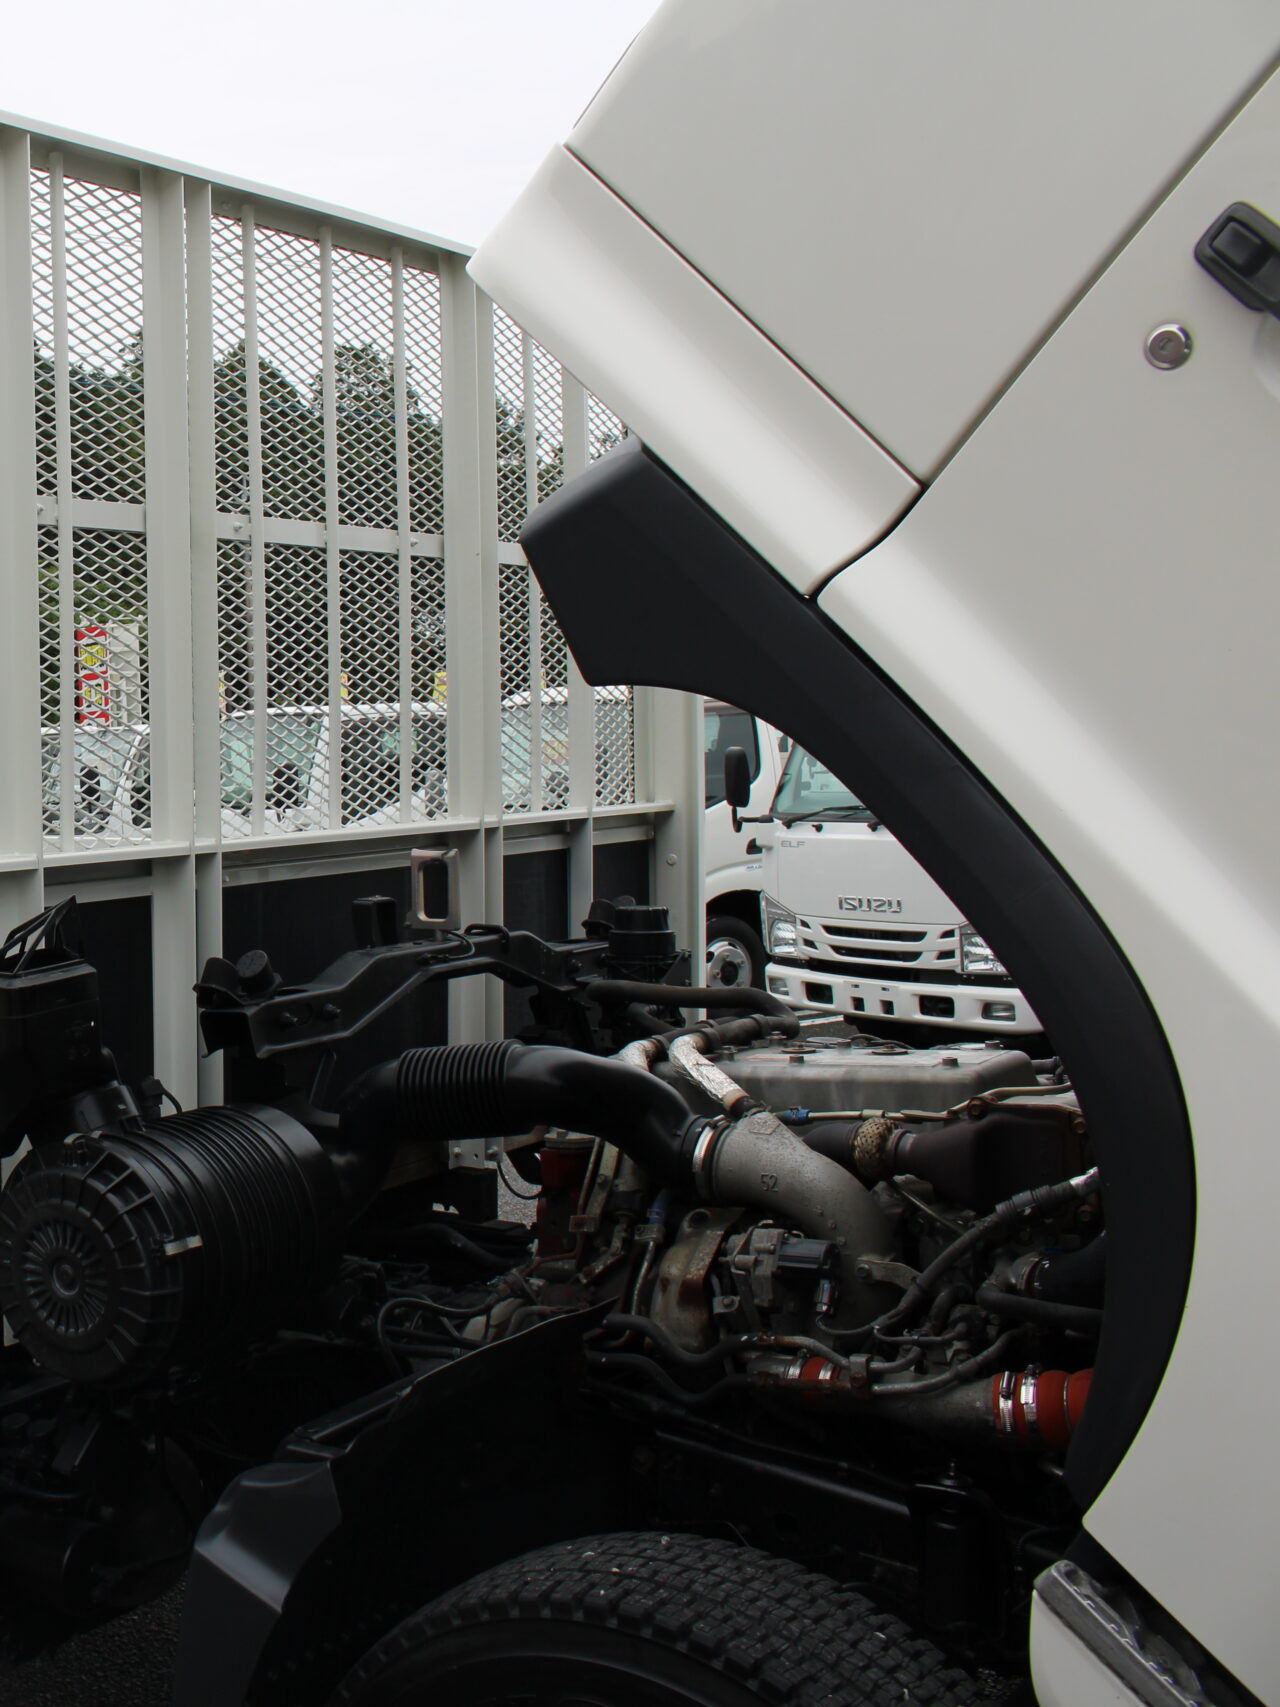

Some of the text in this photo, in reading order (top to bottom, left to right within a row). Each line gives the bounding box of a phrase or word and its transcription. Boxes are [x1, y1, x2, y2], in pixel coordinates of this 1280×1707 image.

[781, 840, 806, 848] ELF
[838, 896, 902, 914] ISUZU
[761, 1173, 778, 1192] 52
